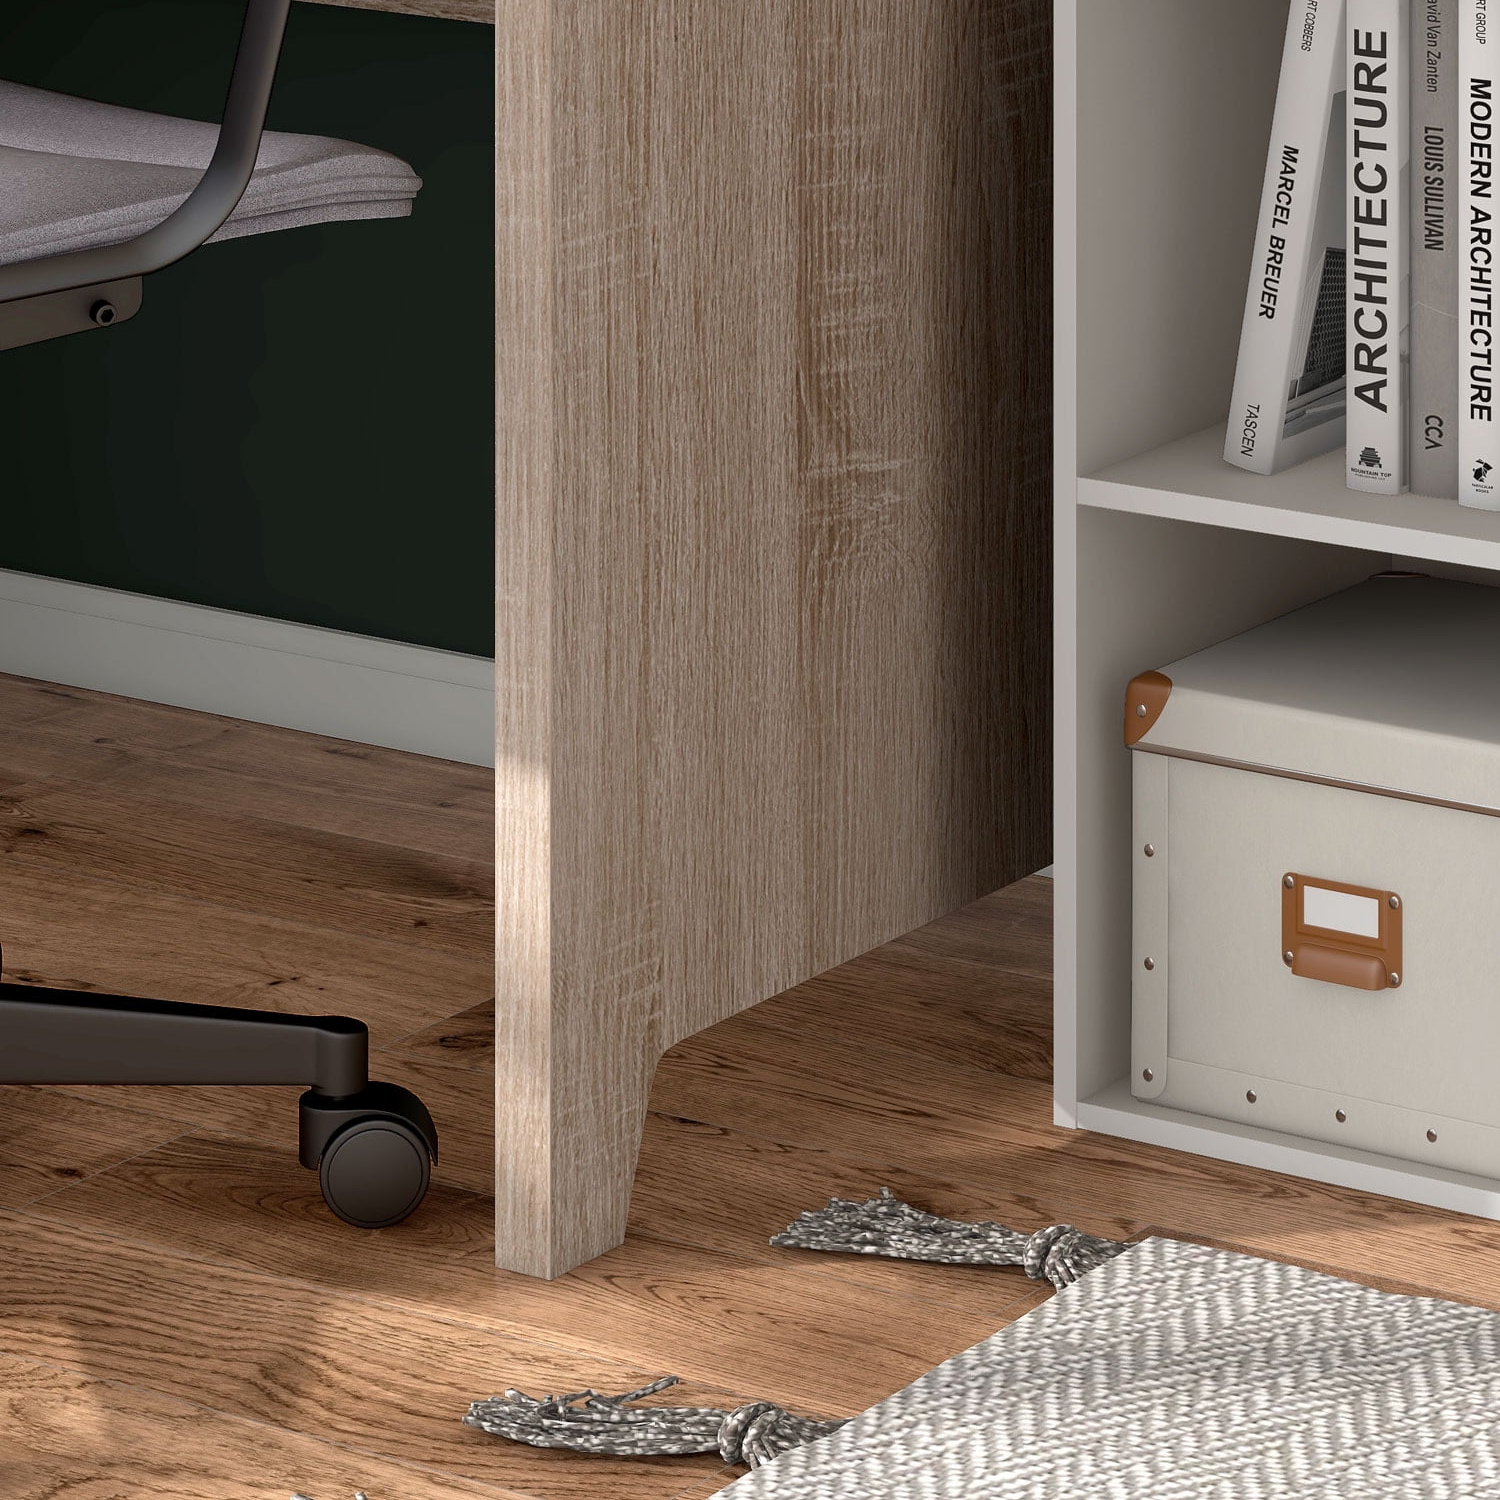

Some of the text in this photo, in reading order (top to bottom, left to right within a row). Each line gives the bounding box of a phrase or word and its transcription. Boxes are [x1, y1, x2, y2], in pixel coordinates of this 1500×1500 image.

[1301, 12, 1316, 52] COBBERS
[1426, 26, 1438, 48] Van
[1475, 14, 1486, 45] GROUP
[1426, 49, 1438, 93] Zanten
[1424, 126, 1444, 252] LOUIS SULLIVAN
[1258, 145, 1299, 320] MARCEL BREUER
[1353, 28, 1388, 414] ARCHITECTURE
[1470, 77, 1492, 422] MODERN ARCHITECTURE
[1240, 403, 1260, 457] TASCEN
